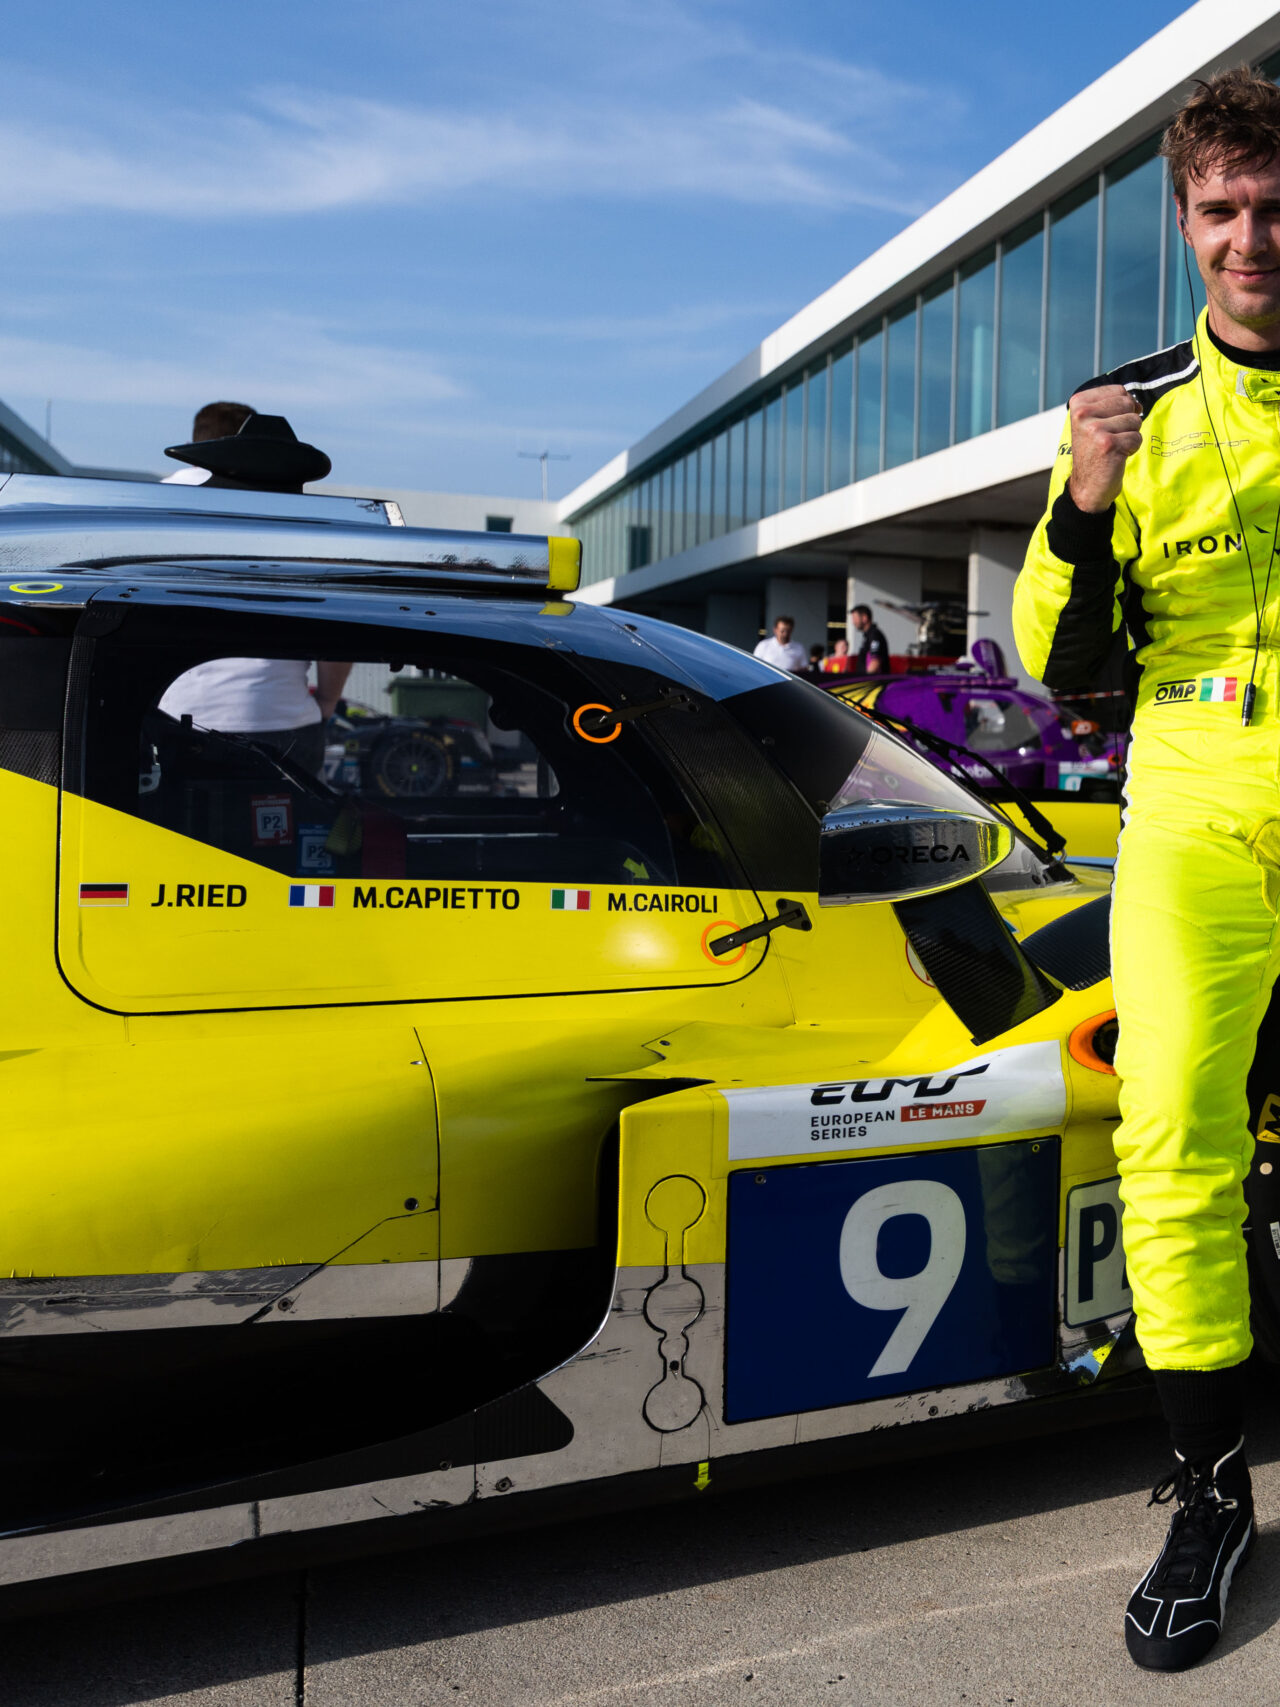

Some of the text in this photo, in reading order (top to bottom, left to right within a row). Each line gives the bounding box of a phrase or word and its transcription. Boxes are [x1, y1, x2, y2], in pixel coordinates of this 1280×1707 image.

[1164, 534, 1242, 558] IRON
[1155, 684, 1196, 701] OMP
[872, 844, 970, 865] ORECA
[151, 884, 247, 908] J.RIED
[353, 886, 520, 910] M.CAPIETTO
[607, 893, 718, 914] M.CAIROLI
[811, 1103, 975, 1127] EUROPEAN LE MANS
[811, 1126, 867, 1141] SERIES
[839, 1180, 966, 1378] 9
